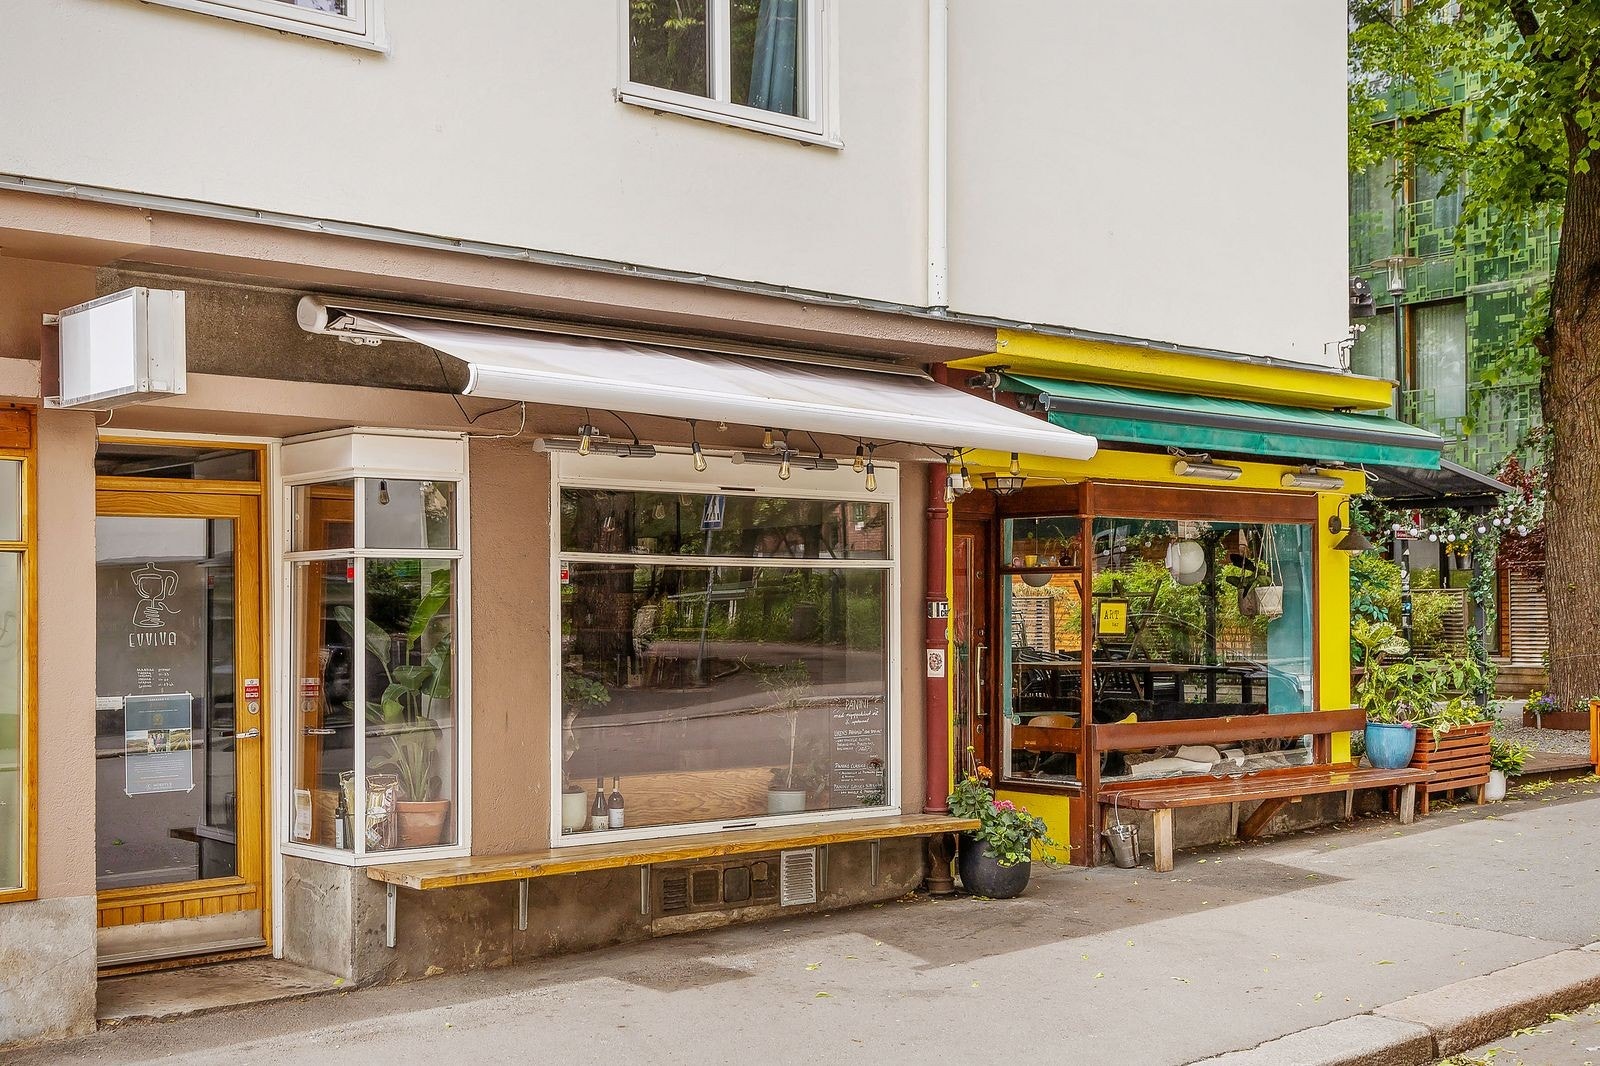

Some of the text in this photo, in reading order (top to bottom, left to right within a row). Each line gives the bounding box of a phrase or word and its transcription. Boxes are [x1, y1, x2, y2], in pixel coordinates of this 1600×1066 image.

[1104, 609, 1119, 620] ART
[129, 631, 177, 648] EVVIVA
[845, 699, 869, 711] PANINI
